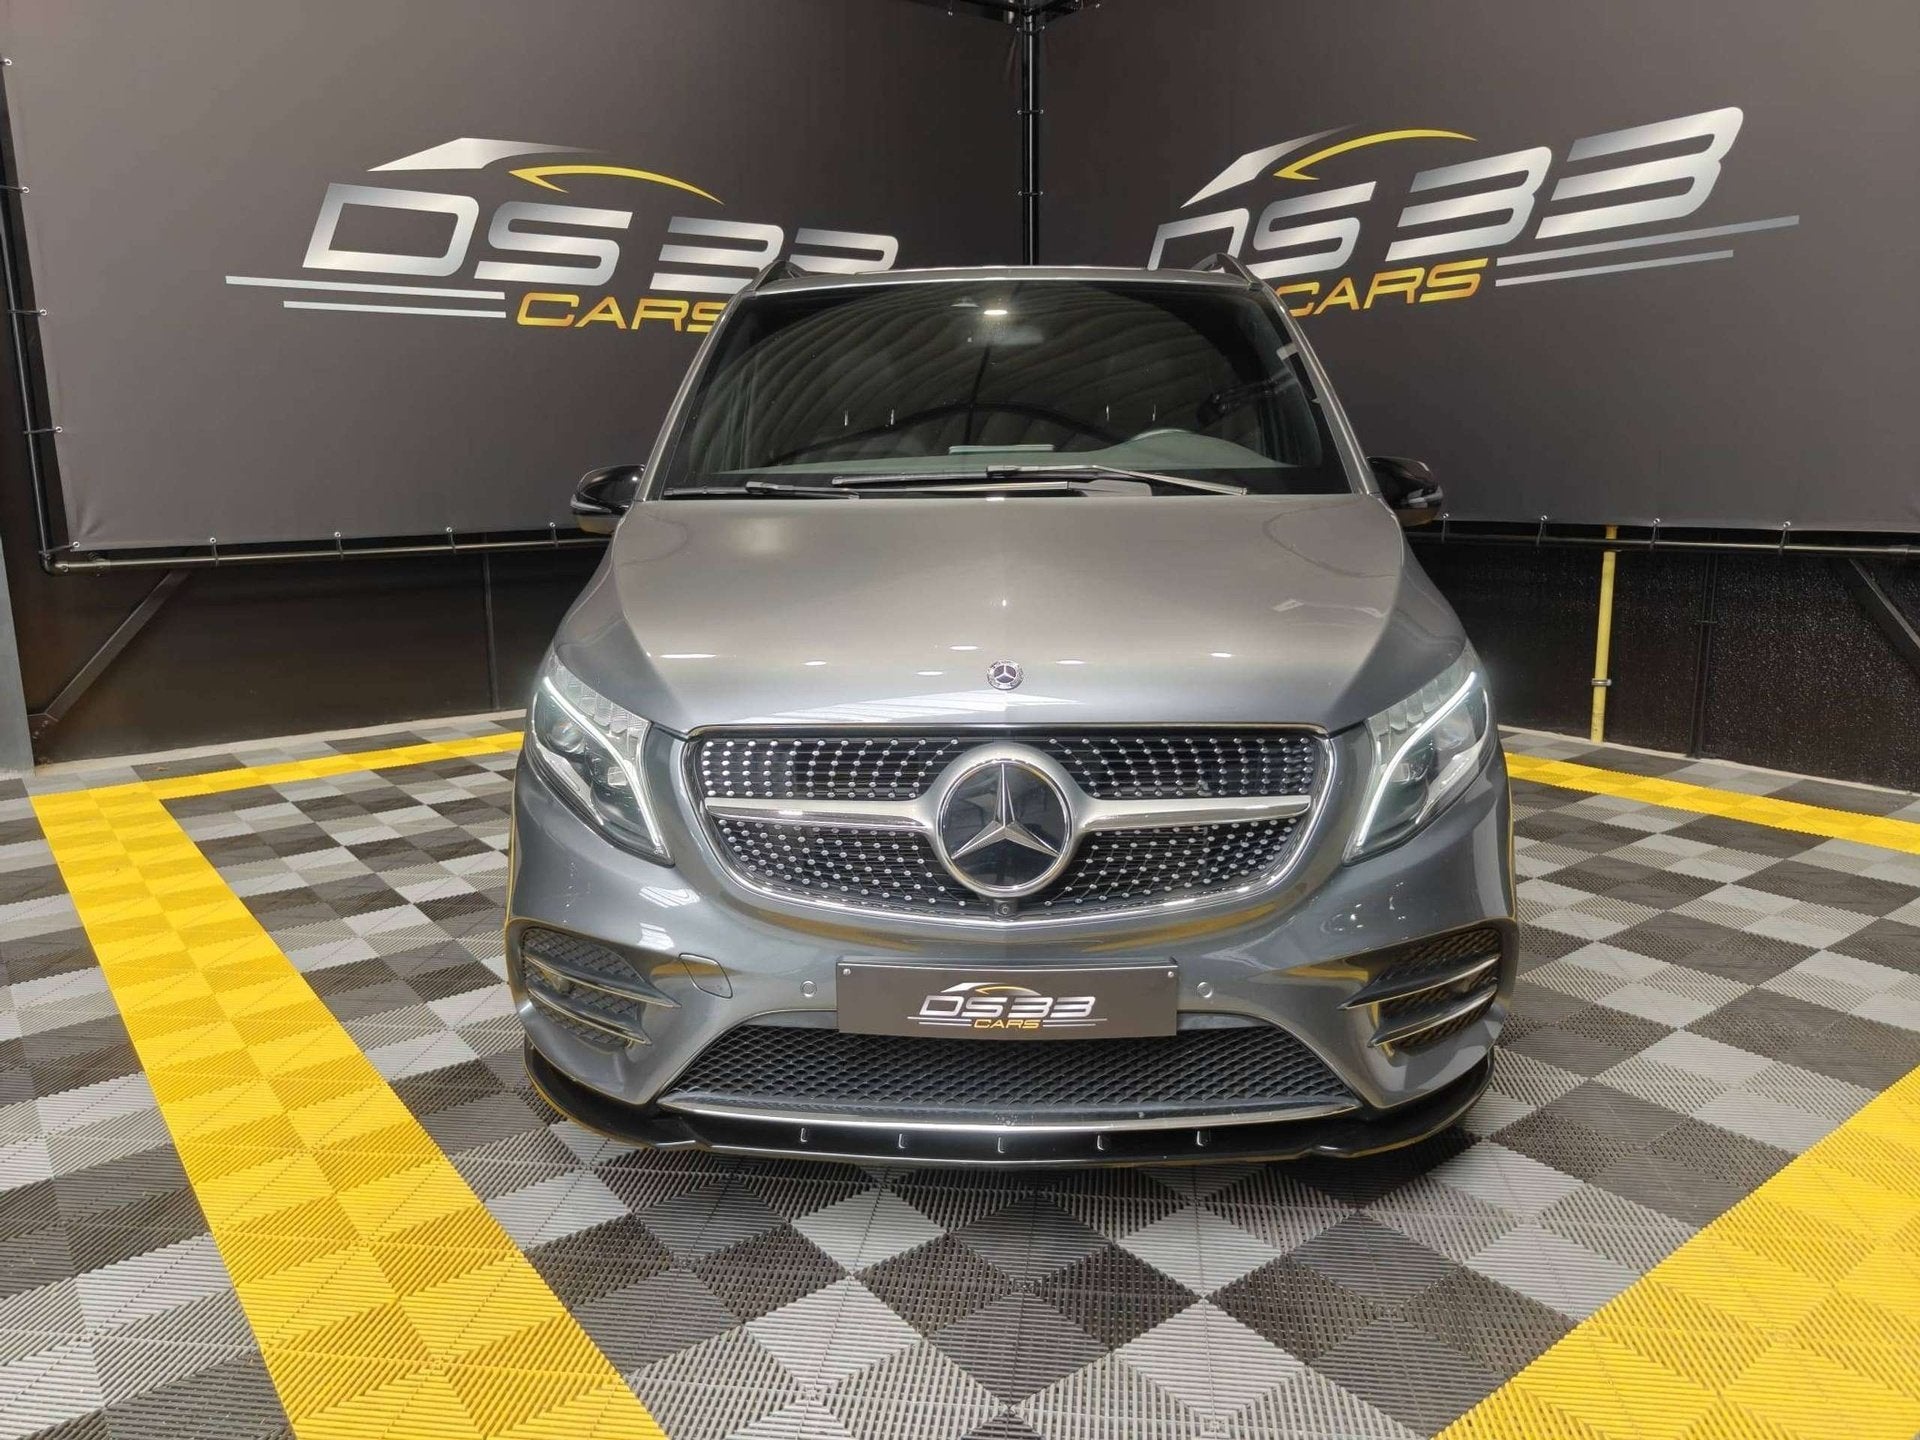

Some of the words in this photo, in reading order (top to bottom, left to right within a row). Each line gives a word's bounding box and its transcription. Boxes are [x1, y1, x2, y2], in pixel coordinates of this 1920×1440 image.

[1275, 257, 1489, 318] CARS
[516, 292, 728, 333] CARS
[974, 1019, 1041, 1029] CARS
